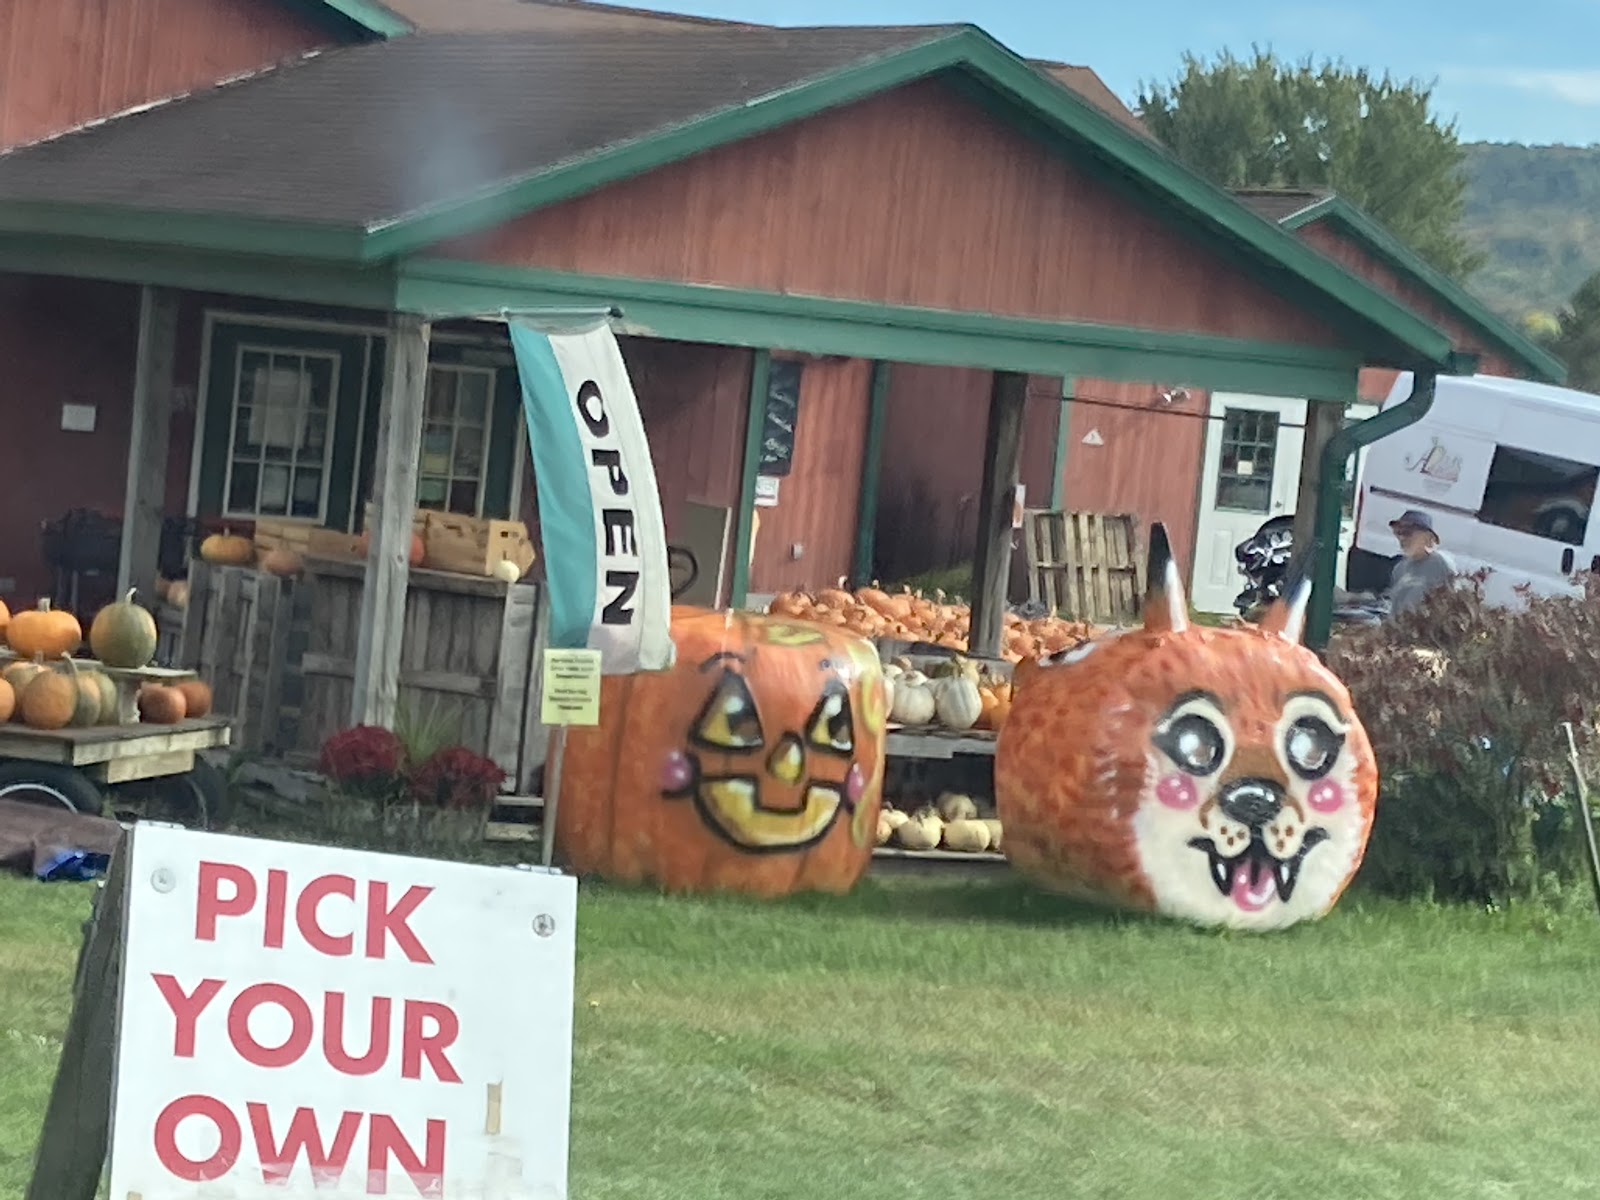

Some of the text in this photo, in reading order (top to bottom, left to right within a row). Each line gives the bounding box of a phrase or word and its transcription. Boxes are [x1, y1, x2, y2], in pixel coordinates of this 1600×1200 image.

[576, 379, 640, 626] OPEN
[195, 860, 435, 965] PICK
[151, 973, 463, 1084] YOUR
[154, 1094, 447, 1199] OWN
